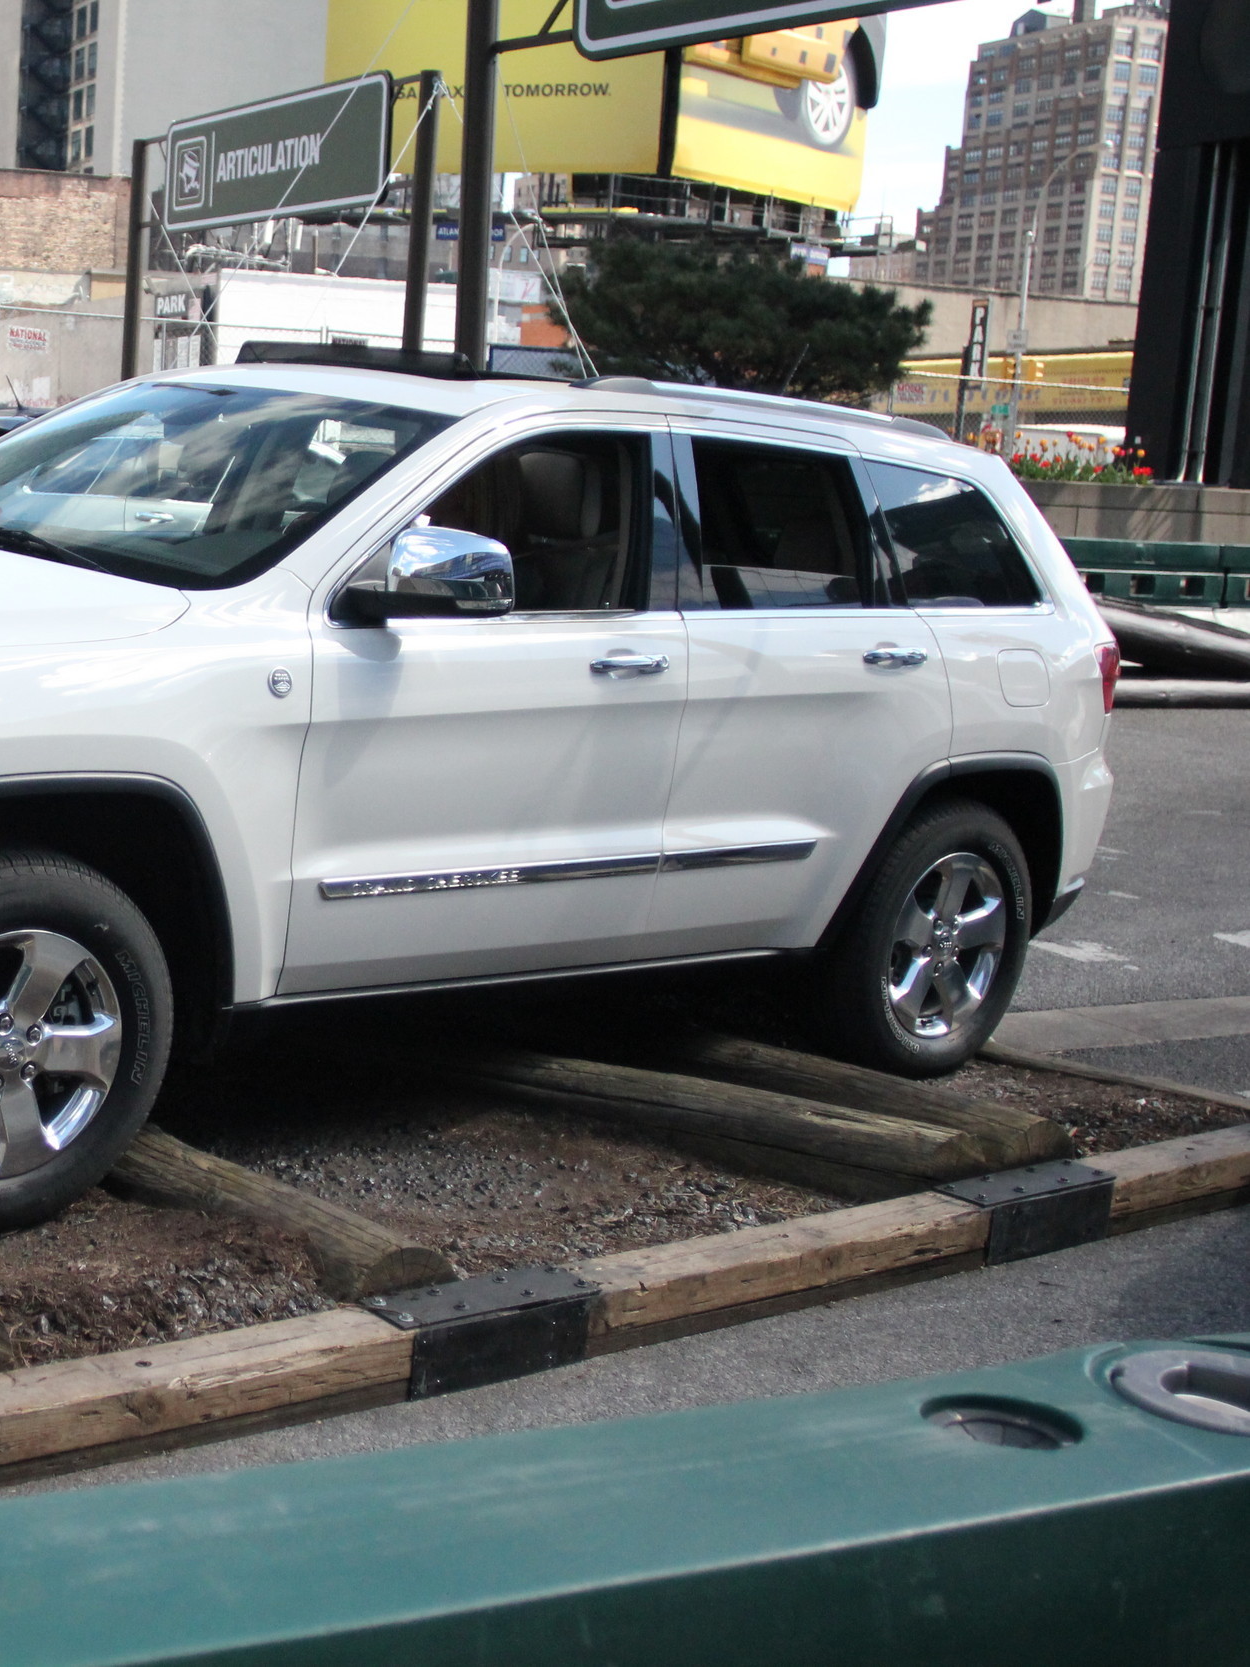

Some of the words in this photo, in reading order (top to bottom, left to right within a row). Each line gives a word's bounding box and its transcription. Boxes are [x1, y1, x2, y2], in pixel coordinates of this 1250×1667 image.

[505, 83, 612, 97] TOMORROW.
[216, 132, 321, 183] ARTICULATION
[157, 294, 186, 315] PARK
[9, 328, 47, 342] NATIONAL
[114, 951, 151, 1086] MICHELIN
